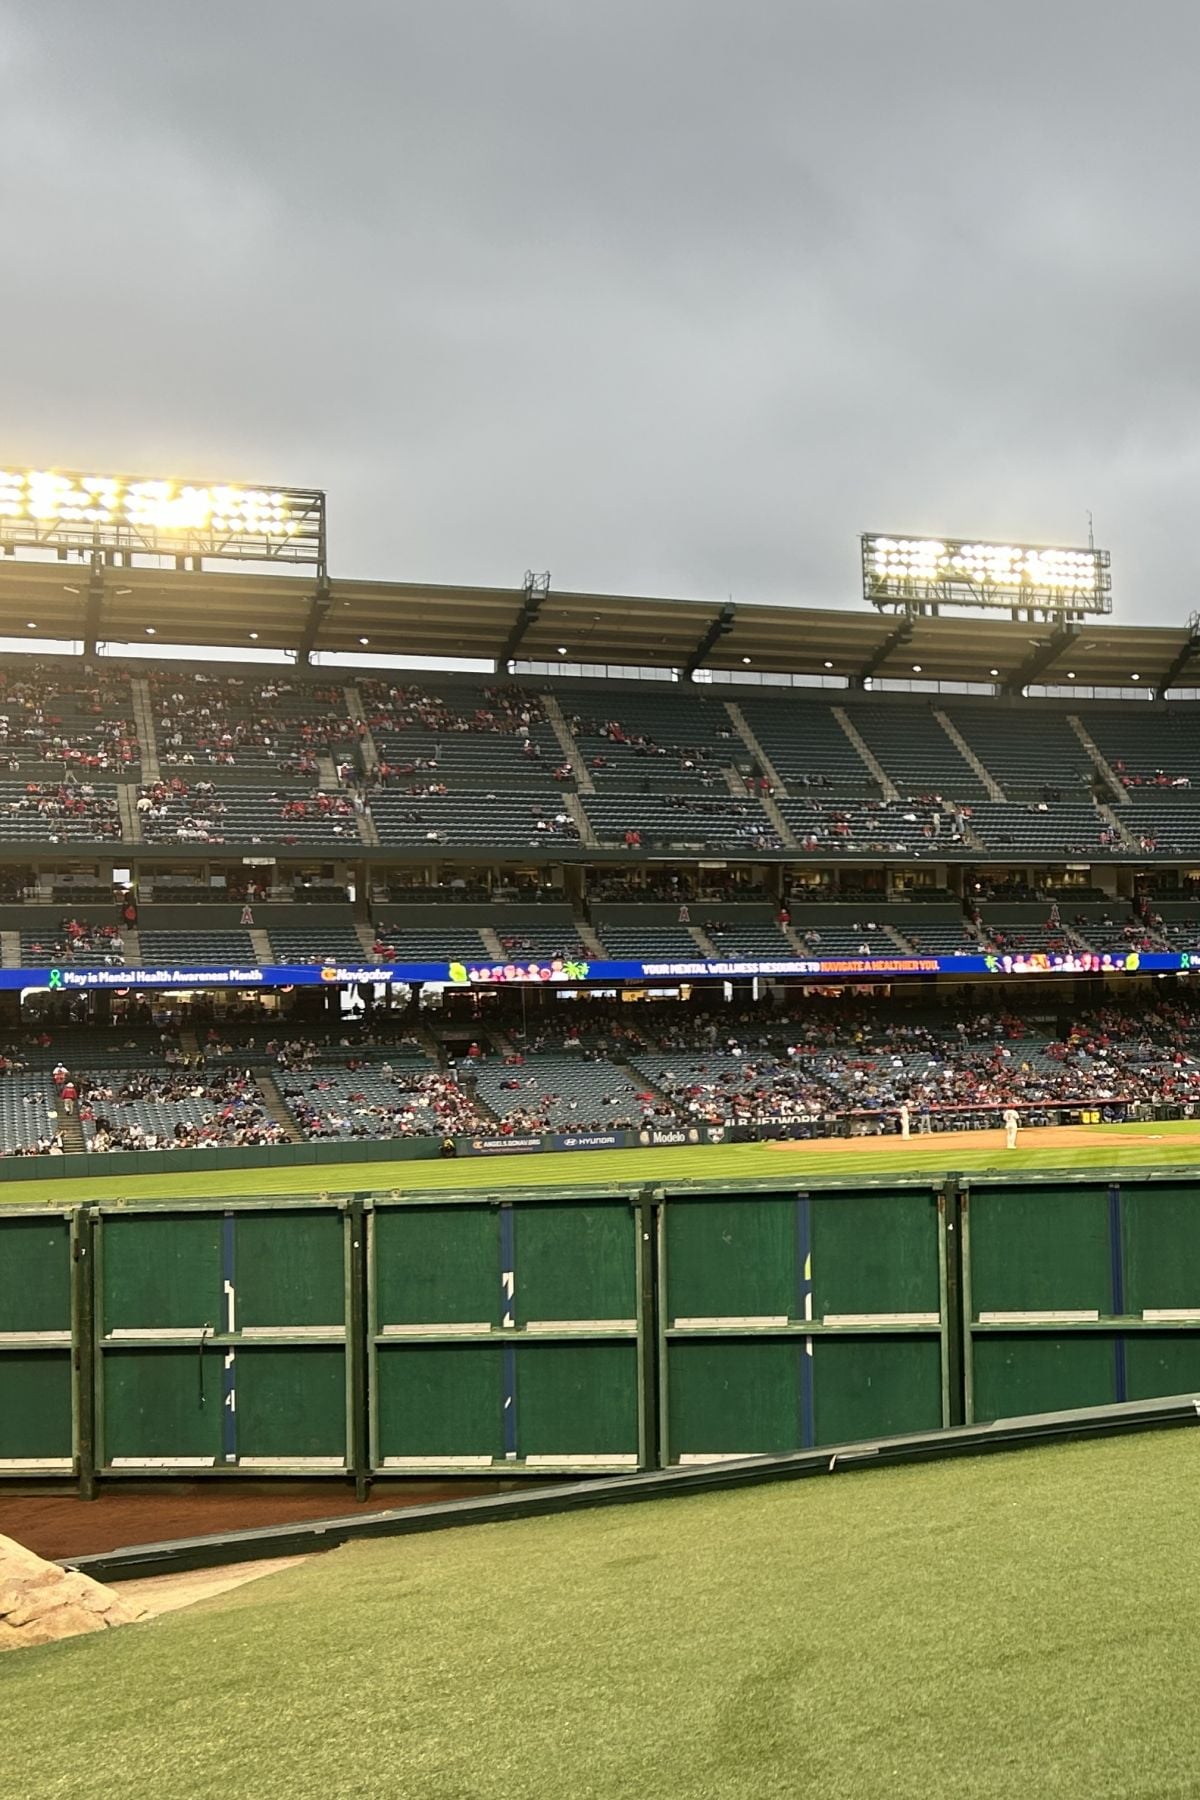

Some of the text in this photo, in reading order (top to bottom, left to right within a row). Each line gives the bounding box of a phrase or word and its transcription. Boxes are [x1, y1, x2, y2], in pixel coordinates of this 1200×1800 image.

[641, 964, 669, 975] YOUR
[670, 963, 708, 974] MENTAL
[707, 962, 758, 974] WELLNESS
[759, 962, 808, 973] RESOURCE
[807, 962, 820, 973] TO
[820, 961, 864, 972] NAVIGATE
[872, 961, 919, 971] HEALTHIER
[64, 970, 263, 985] May is Mental Health Awareness Month
[337, 969, 393, 983] Navigator
[579, 1136, 615, 1145] HYUNDAI
[653, 1131, 685, 1143] Modelo
